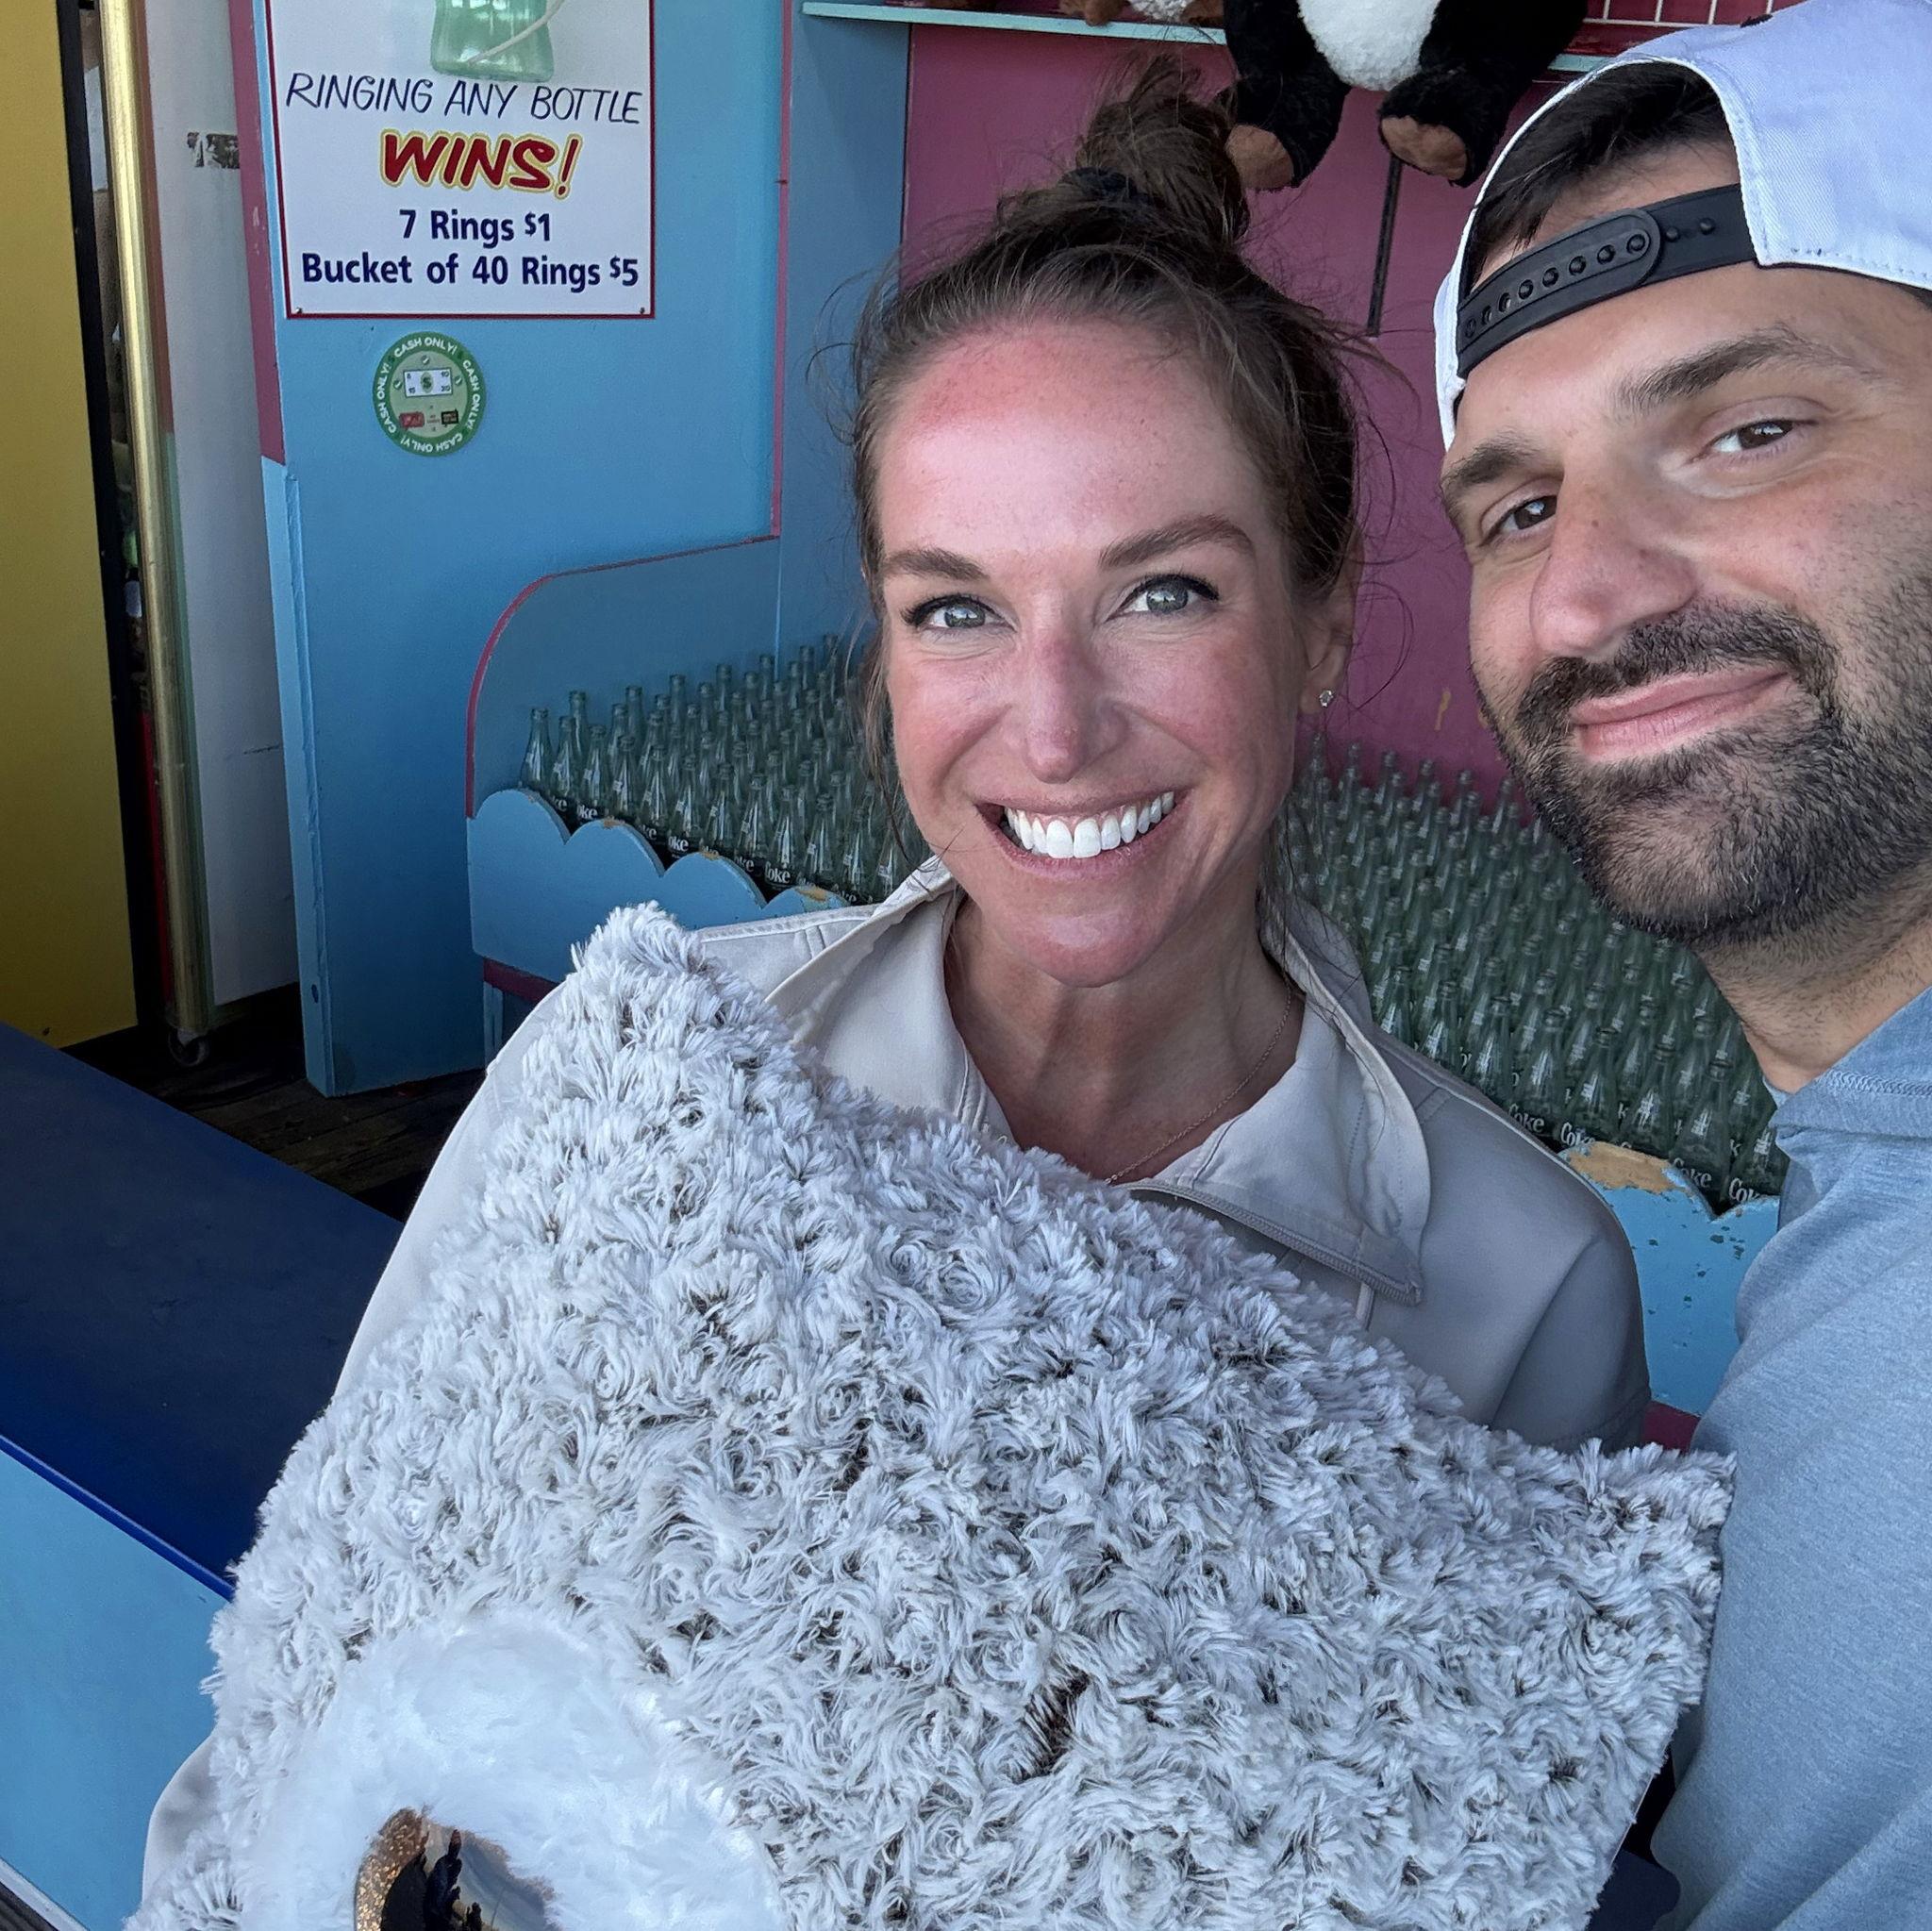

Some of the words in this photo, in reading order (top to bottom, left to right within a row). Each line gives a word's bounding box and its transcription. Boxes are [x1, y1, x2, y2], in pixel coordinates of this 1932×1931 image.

[287, 73, 432, 113] RINGING
[444, 80, 518, 118] ANY
[530, 85, 642, 124] BOTTLE
[380, 128, 582, 200] WINS!
[399, 209, 417, 239] 7
[430, 208, 514, 247] Rings
[525, 213, 552, 241] $1
[302, 252, 412, 284] Bucket
[426, 253, 459, 285] of
[472, 256, 508, 285] 40
[522, 256, 600, 292] Rings
[609, 257, 639, 286] $5
[393, 337, 423, 358] CASH
[424, 337, 457, 355] ONLY!
[377, 362, 392, 400] ONLY!
[462, 359, 480, 391] CASH
[377, 402, 397, 433] CASH
[465, 393, 481, 429] ONLY!
[400, 436, 434, 453] ONLY!
[436, 433, 462, 452] CASH
[765, 860, 791, 885] Coke
